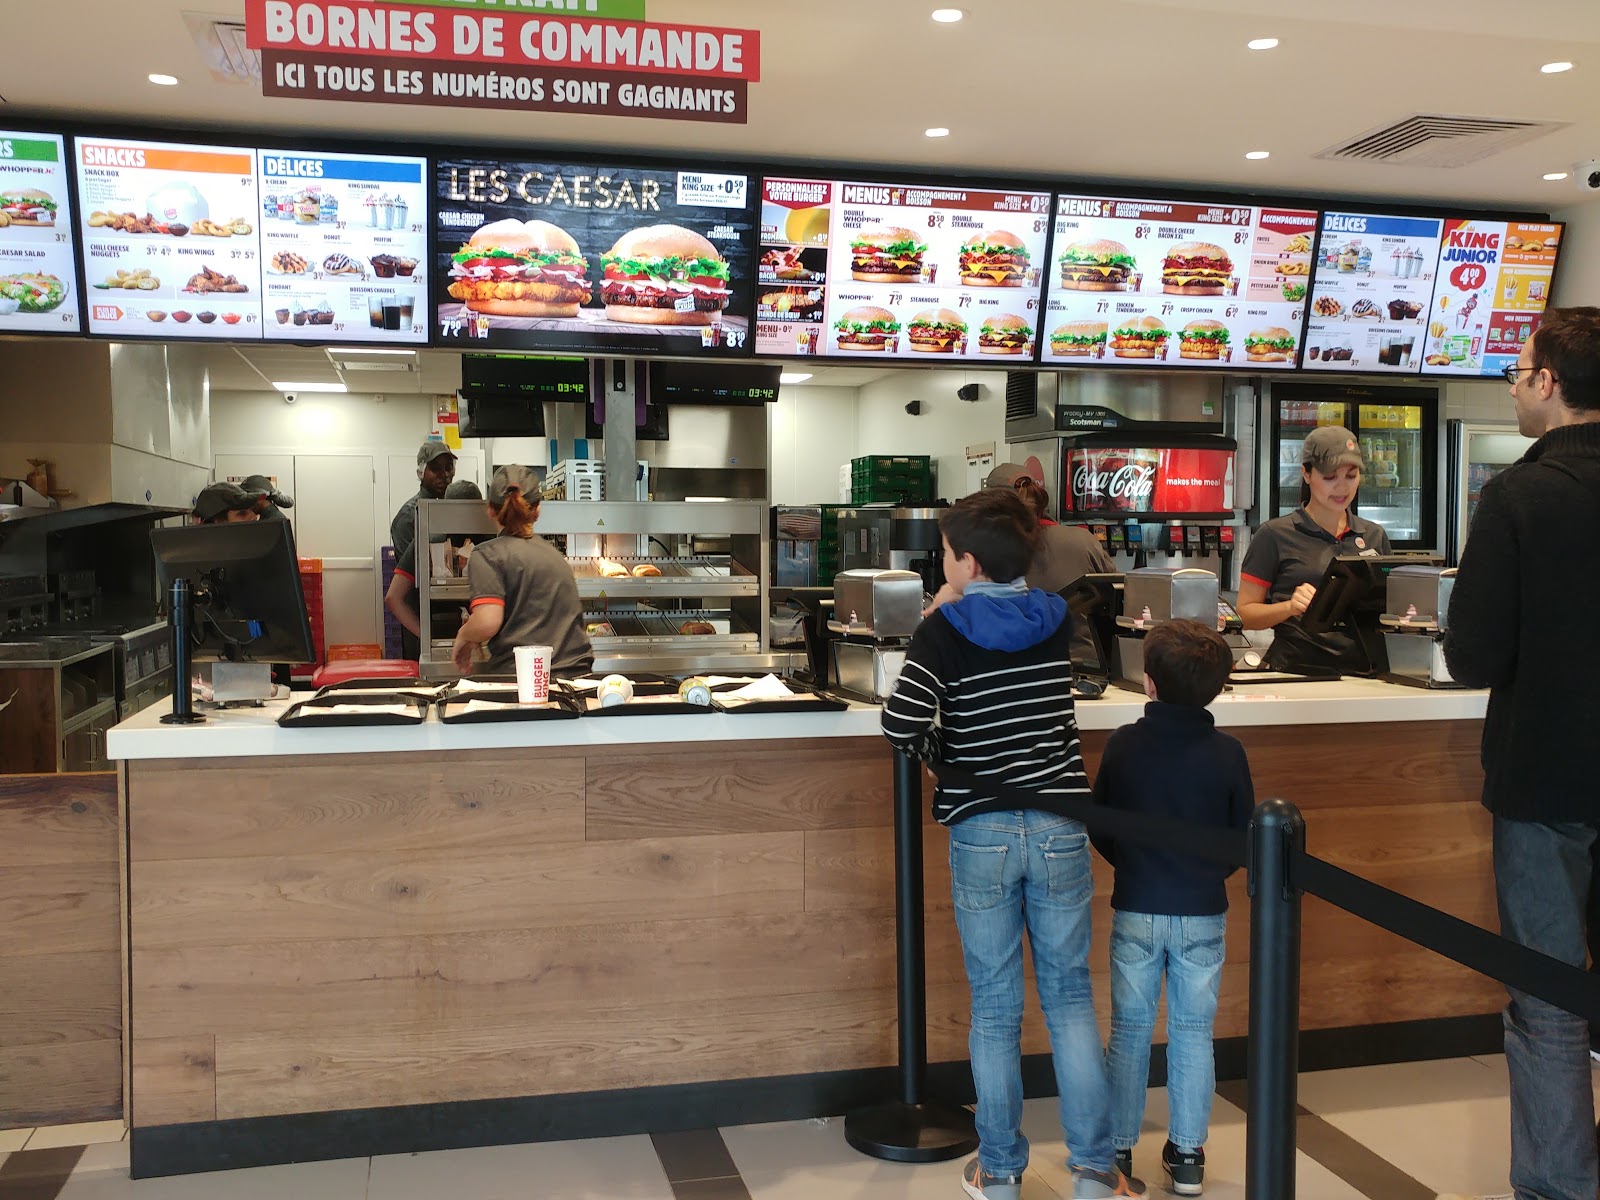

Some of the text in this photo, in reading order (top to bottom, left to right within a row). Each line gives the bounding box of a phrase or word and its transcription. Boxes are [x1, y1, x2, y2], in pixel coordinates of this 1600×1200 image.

[265, 1, 744, 74] BORNES DE COMMANDE
[276, 62, 736, 114] ICI TOUS LES NUMÉROS SONT GAGNANTS
[85, 146, 146, 168] SNACKS
[266, 157, 324, 178] DÉLICES
[682, 175, 702, 183] MENU
[450, 167, 661, 212] LES CAESAR
[700, 184, 715, 192] SIZE
[765, 181, 828, 195] PERSONNALISEZ
[769, 190, 824, 203] VOTRE BURGER
[844, 186, 890, 204] MENUS
[993, 202, 1022, 211] KING SIZE
[1058, 199, 1101, 216] MENUS
[951, 221, 984, 230] STEAKHOUSE
[1261, 214, 1317, 227] ACCOMPAGNEMENT
[1324, 214, 1367, 232] DÉLICES
[1158, 226, 1195, 235] DOUBLE CHEESE
[1449, 231, 1500, 249] KING
[24, 249, 46, 258] SALAD
[194, 248, 215, 256] WINGS
[1443, 248, 1497, 264] JUNIOR
[910, 296, 940, 304] STEAKHOUSE
[756, 324, 778, 333] MENU
[557, 382, 585, 394] 03:42
[748, 386, 774, 399] 03:42
[1069, 418, 1103, 427] Scotsman
[1166, 477, 1221, 487] makes the meal
[534, 657, 543, 698] BURGER
